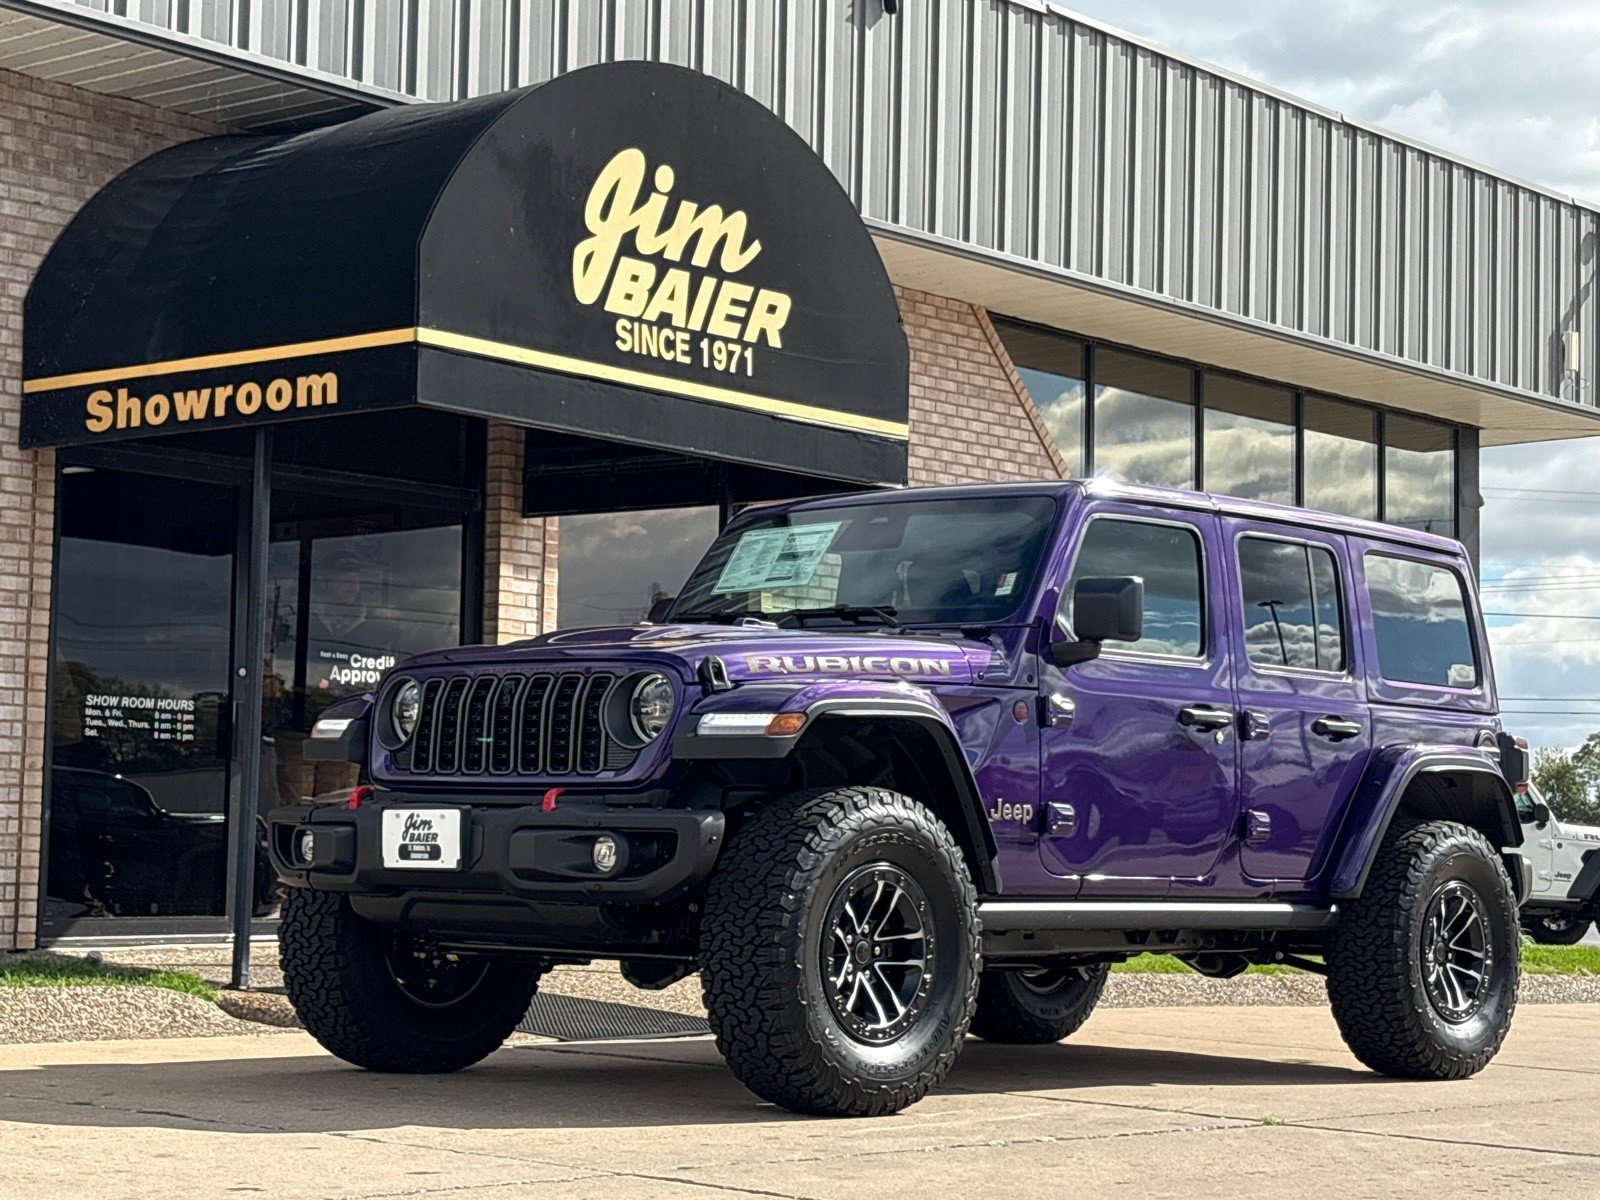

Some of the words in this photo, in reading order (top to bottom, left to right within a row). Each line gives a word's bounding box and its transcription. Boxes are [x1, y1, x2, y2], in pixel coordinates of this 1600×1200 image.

[572, 148, 762, 305] Jim
[604, 256, 792, 349] BAIER
[615, 319, 691, 364] SINCE
[700, 337, 753, 377] 1971
[85, 371, 338, 433] Showroom
[350, 654, 395, 669] Credit
[744, 655, 952, 677] RUBICON
[86, 694, 119, 707] SHOW
[121, 697, 155, 709] ROOM
[157, 699, 195, 711] HOURS
[990, 798, 1033, 825] Jeep
[402, 812, 433, 842] Jim
[408, 832, 439, 843] BAIER
[1554, 871, 1571, 879] Jeep
